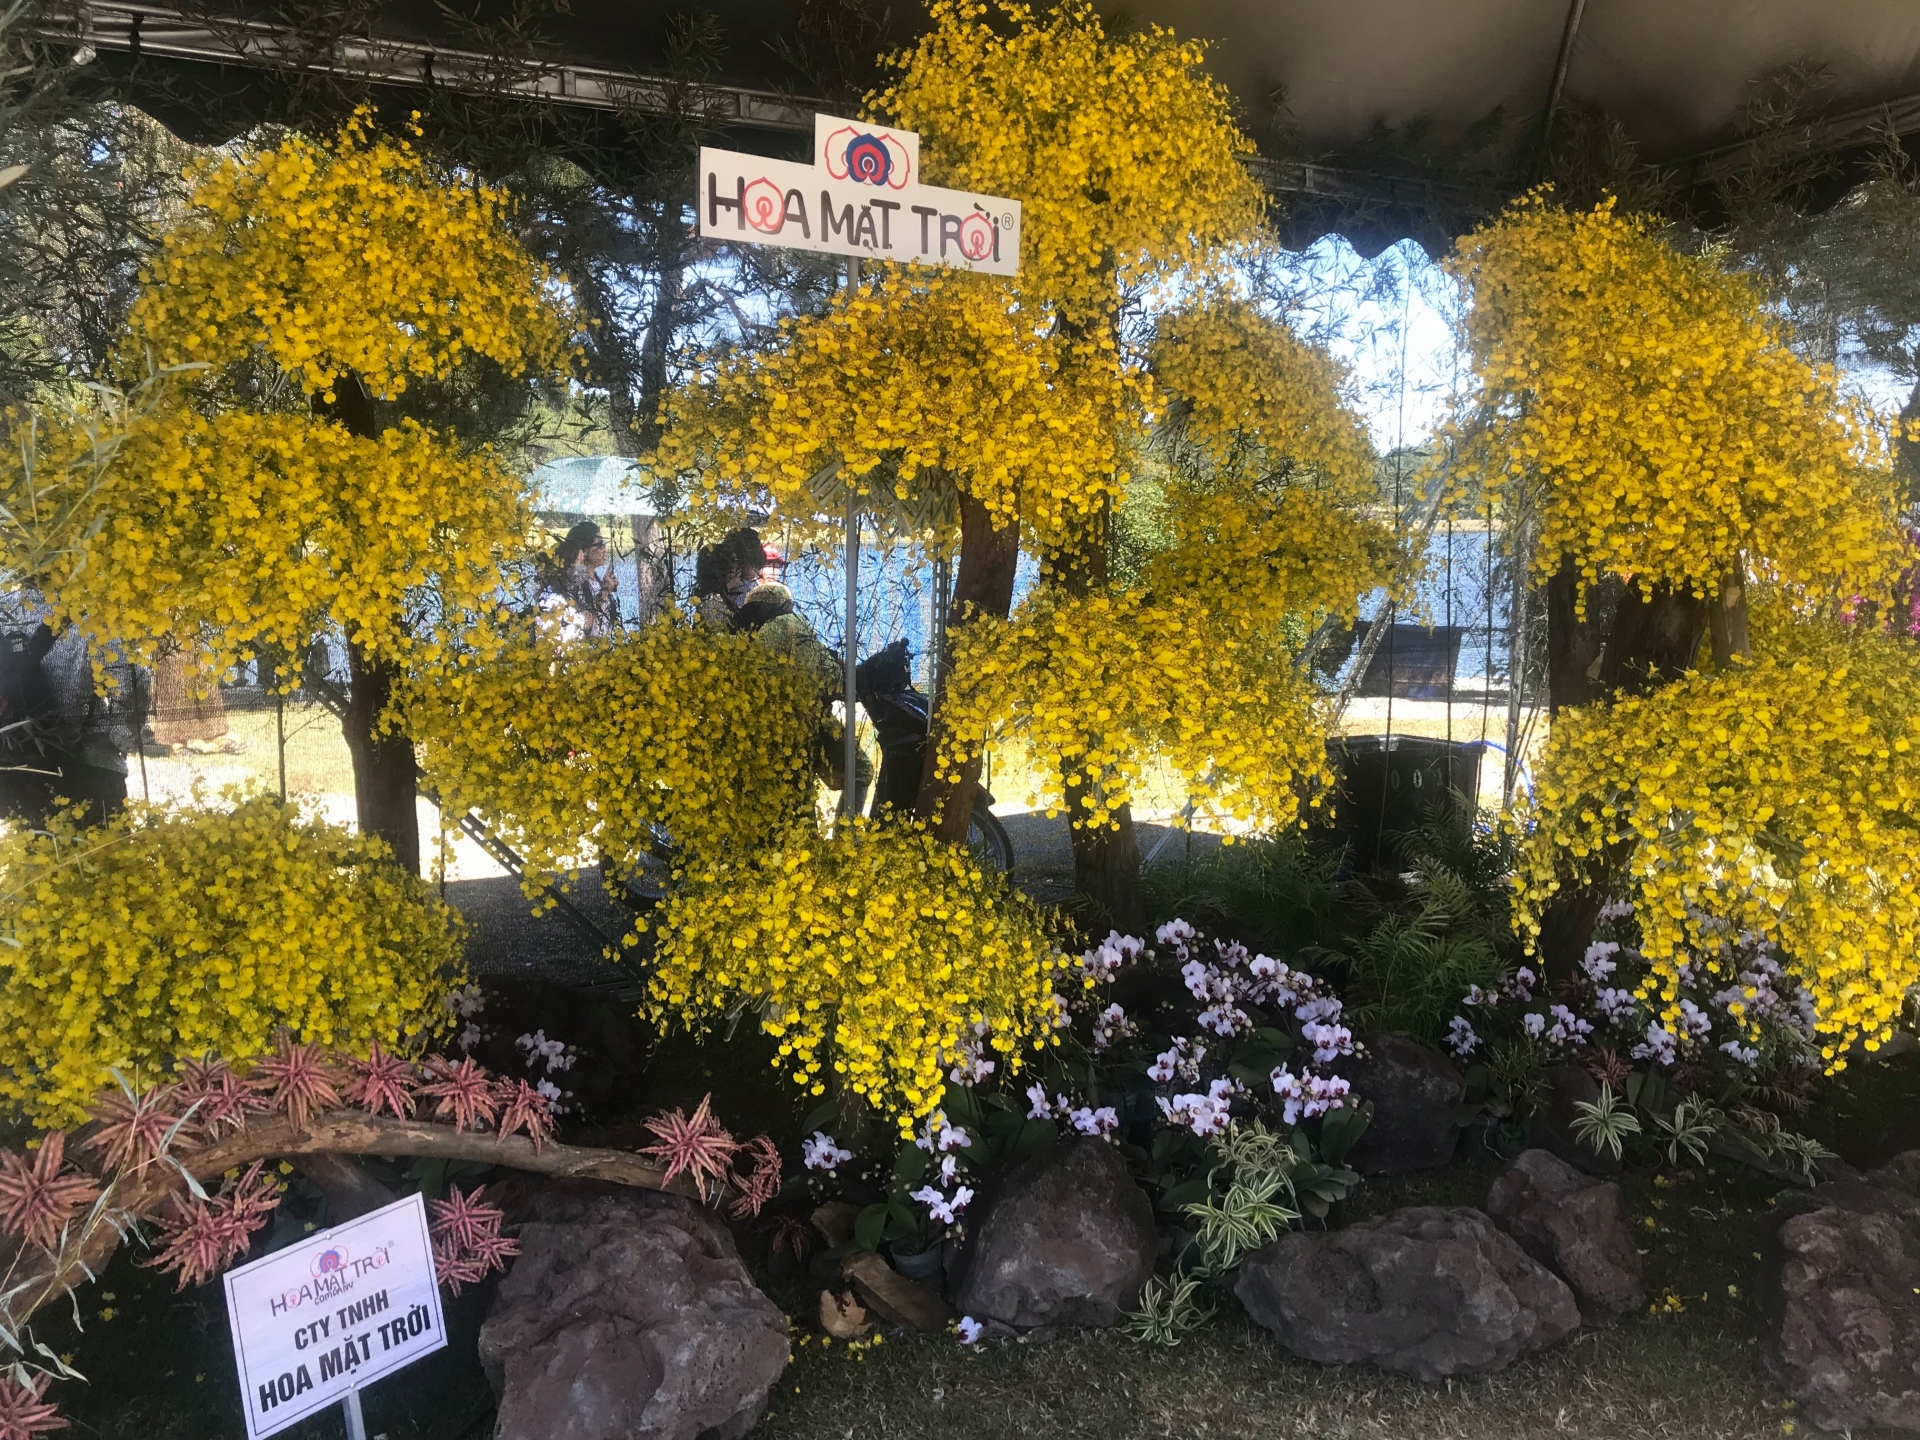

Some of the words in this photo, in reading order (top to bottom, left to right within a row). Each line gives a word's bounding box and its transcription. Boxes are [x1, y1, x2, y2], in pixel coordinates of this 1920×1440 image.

[708, 171, 811, 240] HOA
[820, 189, 901, 251] MẶT
[270, 1284, 314, 1317] HOA
[294, 1315, 330, 1351] CTY
[336, 1289, 390, 1330] TNHH
[258, 1363, 314, 1413] HOA
[318, 1333, 371, 1383] MẶT
[377, 1303, 432, 1347] TRỜI
